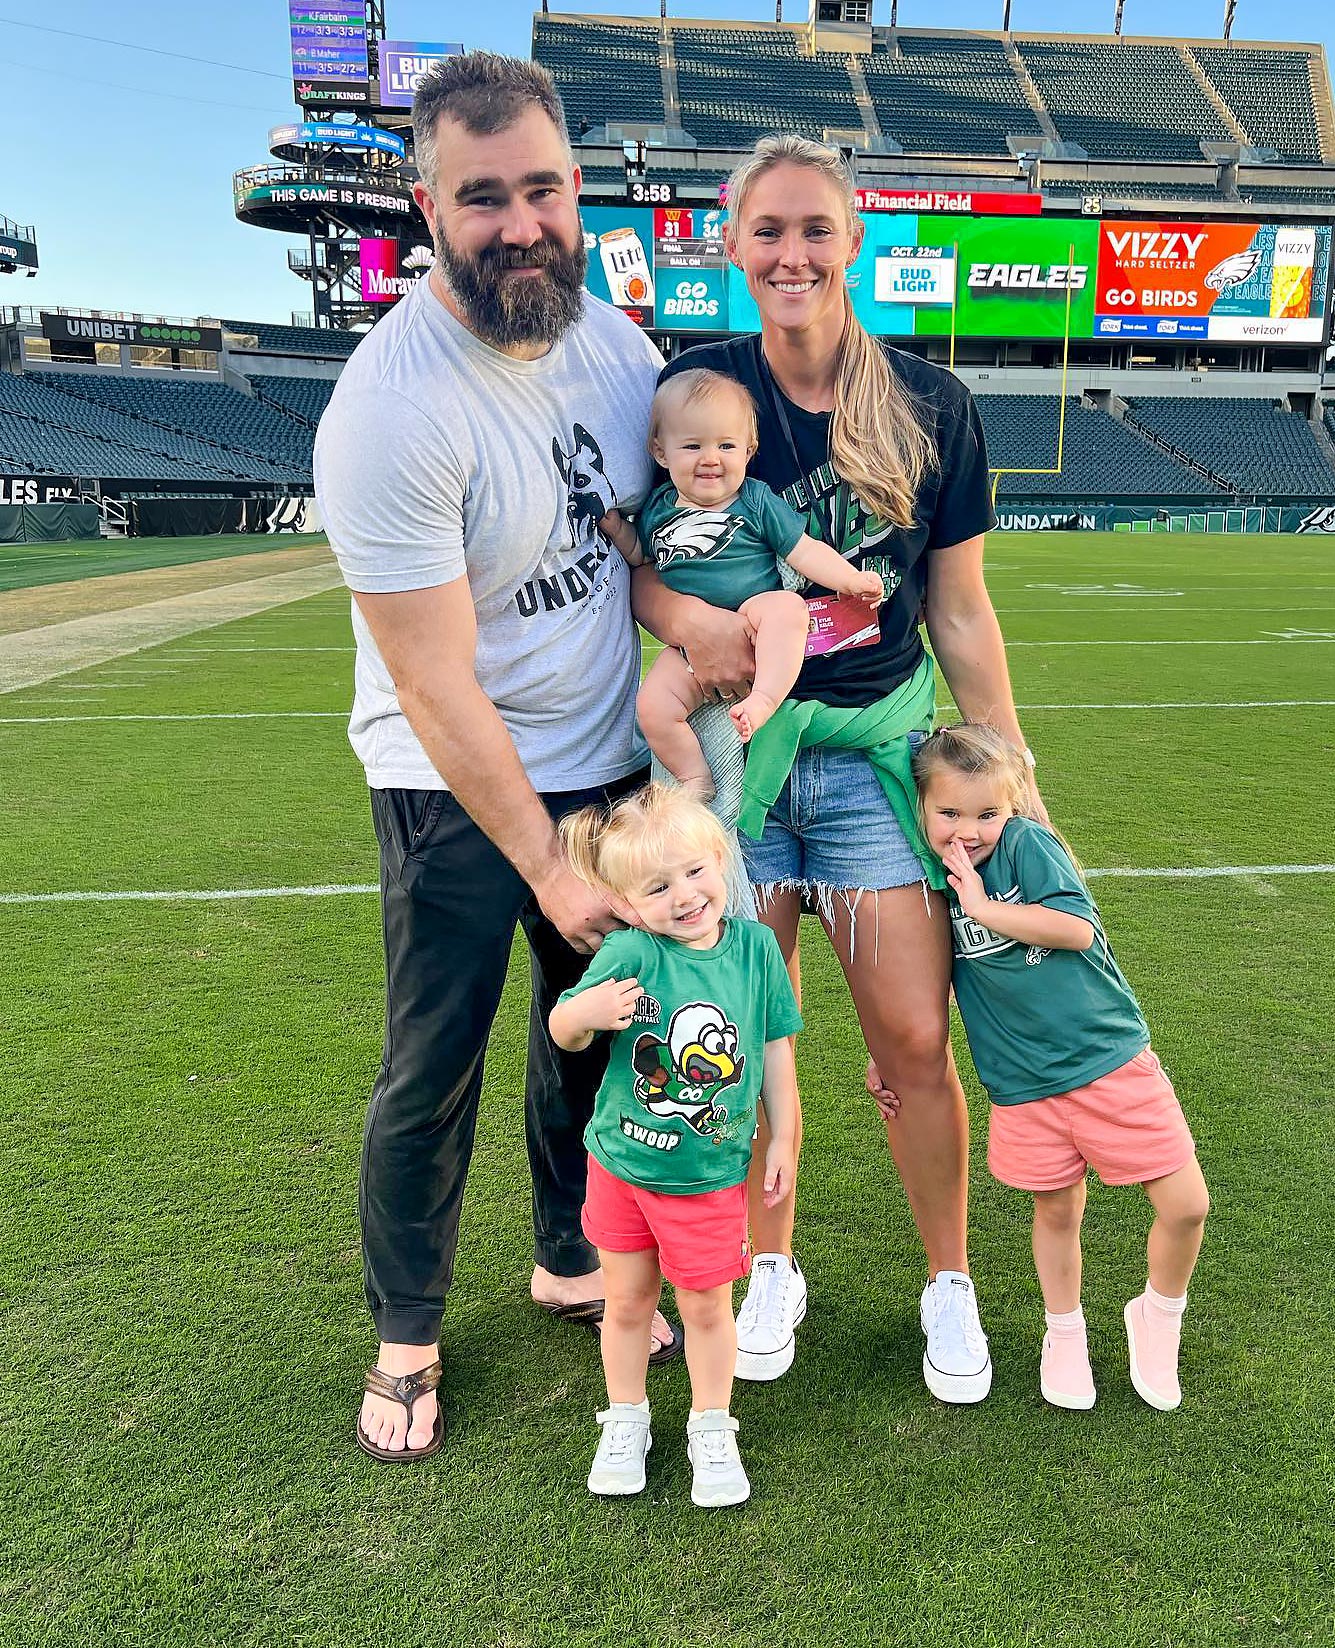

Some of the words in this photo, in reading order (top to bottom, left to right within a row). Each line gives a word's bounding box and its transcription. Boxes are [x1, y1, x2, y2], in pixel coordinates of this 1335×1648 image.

[316, 25, 331, 36] 3/3
[339, 26, 354, 36] 3/3
[318, 62, 333, 73] 3/5
[341, 63, 356, 74] 2/2
[391, 73, 426, 91] LIG
[300, 90, 367, 101] DRAFTKINGS
[317, 129, 334, 137] BUD
[334, 129, 356, 138] LIGHT
[270, 190, 297, 202] THIS
[300, 189, 338, 202] GAME
[341, 190, 354, 203] IS
[632, 183, 671, 202] 3:58
[865, 191, 932, 210] Financial
[934, 193, 972, 211] Field
[1083, 198, 1101, 213] 25
[664, 221, 680, 237] 31
[702, 222, 720, 238] 34
[663, 244, 683, 253] FINAL
[890, 246, 914, 257] OCT.
[916, 246, 942, 258] 22nd
[1106, 231, 1205, 260] VIZZY
[1278, 243, 1311, 254] VIZZY
[1115, 260, 1145, 269] HARD
[1149, 261, 1196, 270] SELTZER
[900, 268, 931, 280] BUD
[967, 263, 1088, 289] EAGLES
[675, 281, 708, 299] GO
[893, 280, 937, 292] LIGHT
[1105, 288, 1137, 306] GO
[1141, 289, 1199, 308] BIRDS
[663, 298, 719, 317] BIRDS
[66, 319, 137, 341] UNIBET
[1243, 324, 1284, 335] verizon
[623, 1121, 679, 1151] SWOOP
